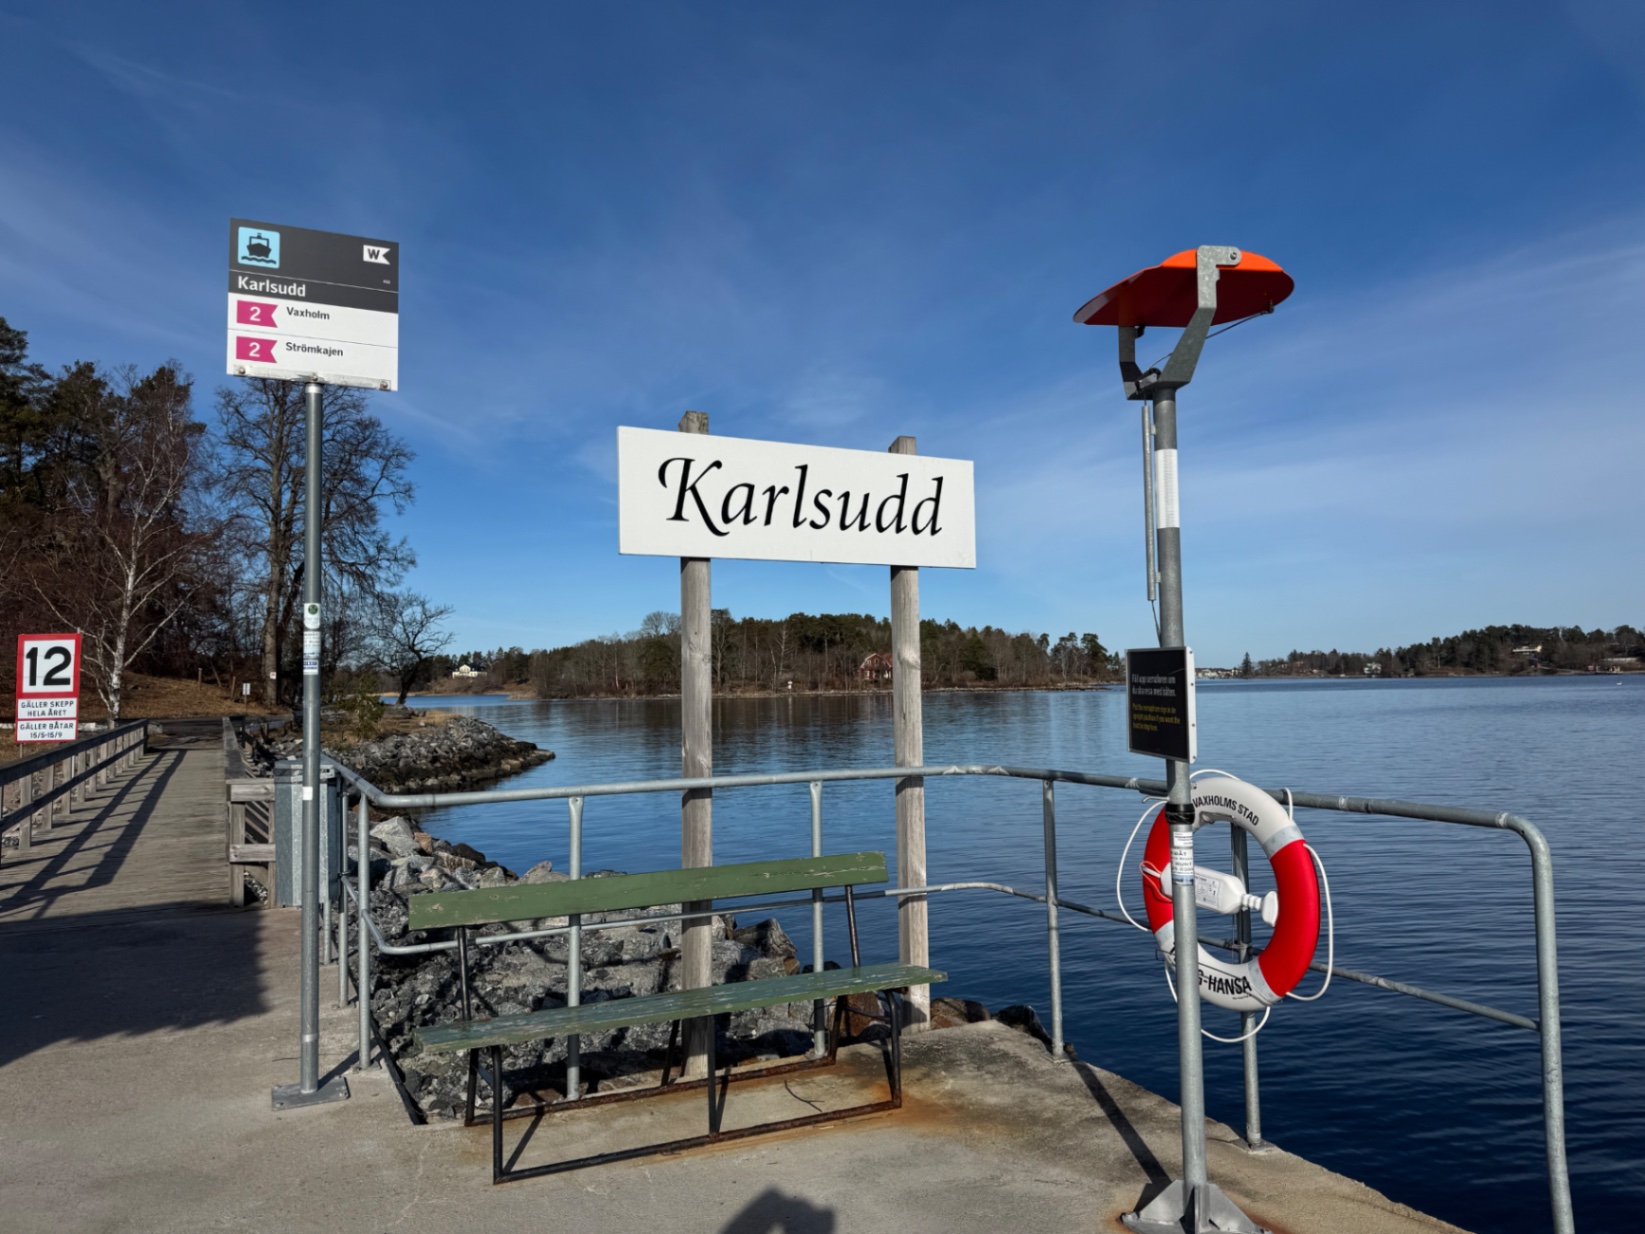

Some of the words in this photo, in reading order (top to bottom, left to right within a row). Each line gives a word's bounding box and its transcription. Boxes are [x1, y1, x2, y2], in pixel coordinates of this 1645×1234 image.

[367, 248, 380, 260] W
[237, 275, 306, 297] Karlsudd
[249, 306, 261, 322] 2
[286, 306, 330, 320] Vaxholm
[248, 342, 261, 357] 2
[285, 341, 344, 357] Strömkajen
[657, 457, 944, 537] Karlsudd
[25, 645, 72, 686] 12
[21, 700, 48, 709] GÄLLER
[50, 700, 74, 708] SKEPP
[27, 709, 46, 717] HELA
[47, 708, 67, 716] ÅRET
[20, 722, 47, 730] GÄLLER
[49, 721, 74, 729] BÅTAR
[1192, 795, 1238, 811] VAXHOLMS
[1237, 803, 1259, 827] STAD
